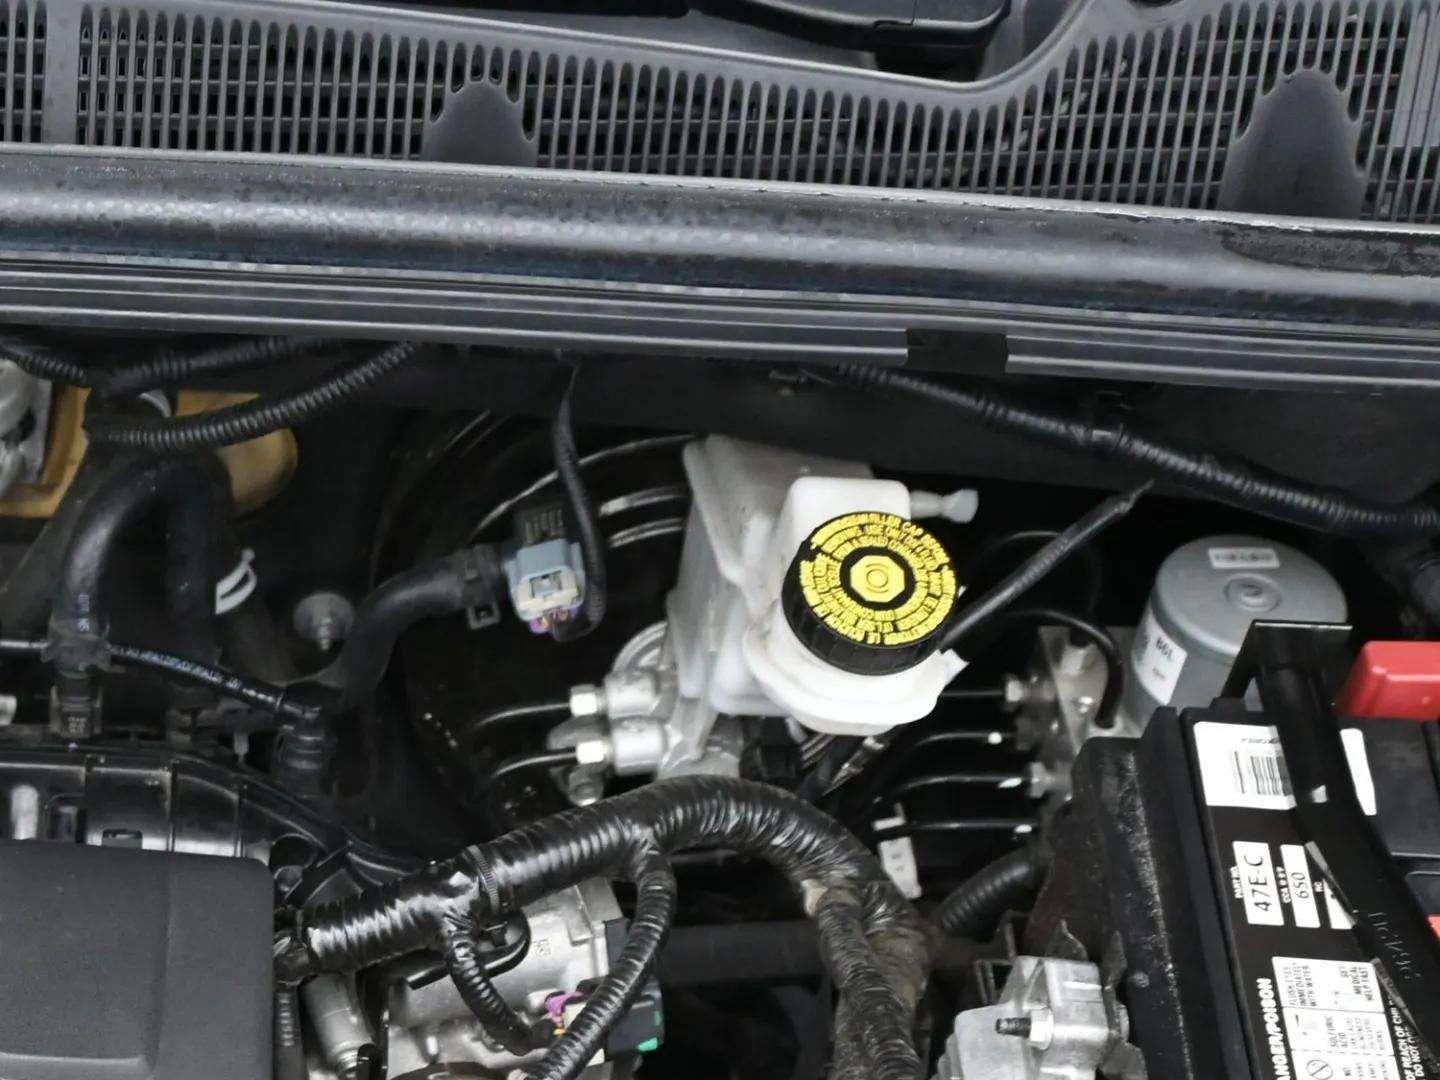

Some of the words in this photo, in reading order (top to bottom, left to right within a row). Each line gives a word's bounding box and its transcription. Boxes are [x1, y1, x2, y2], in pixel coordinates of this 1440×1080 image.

[902, 521, 924, 537] CAP
[1243, 855, 1272, 912] 47E-C
[1291, 871, 1309, 899] 650
[1397, 1039, 1412, 1068] REACH
